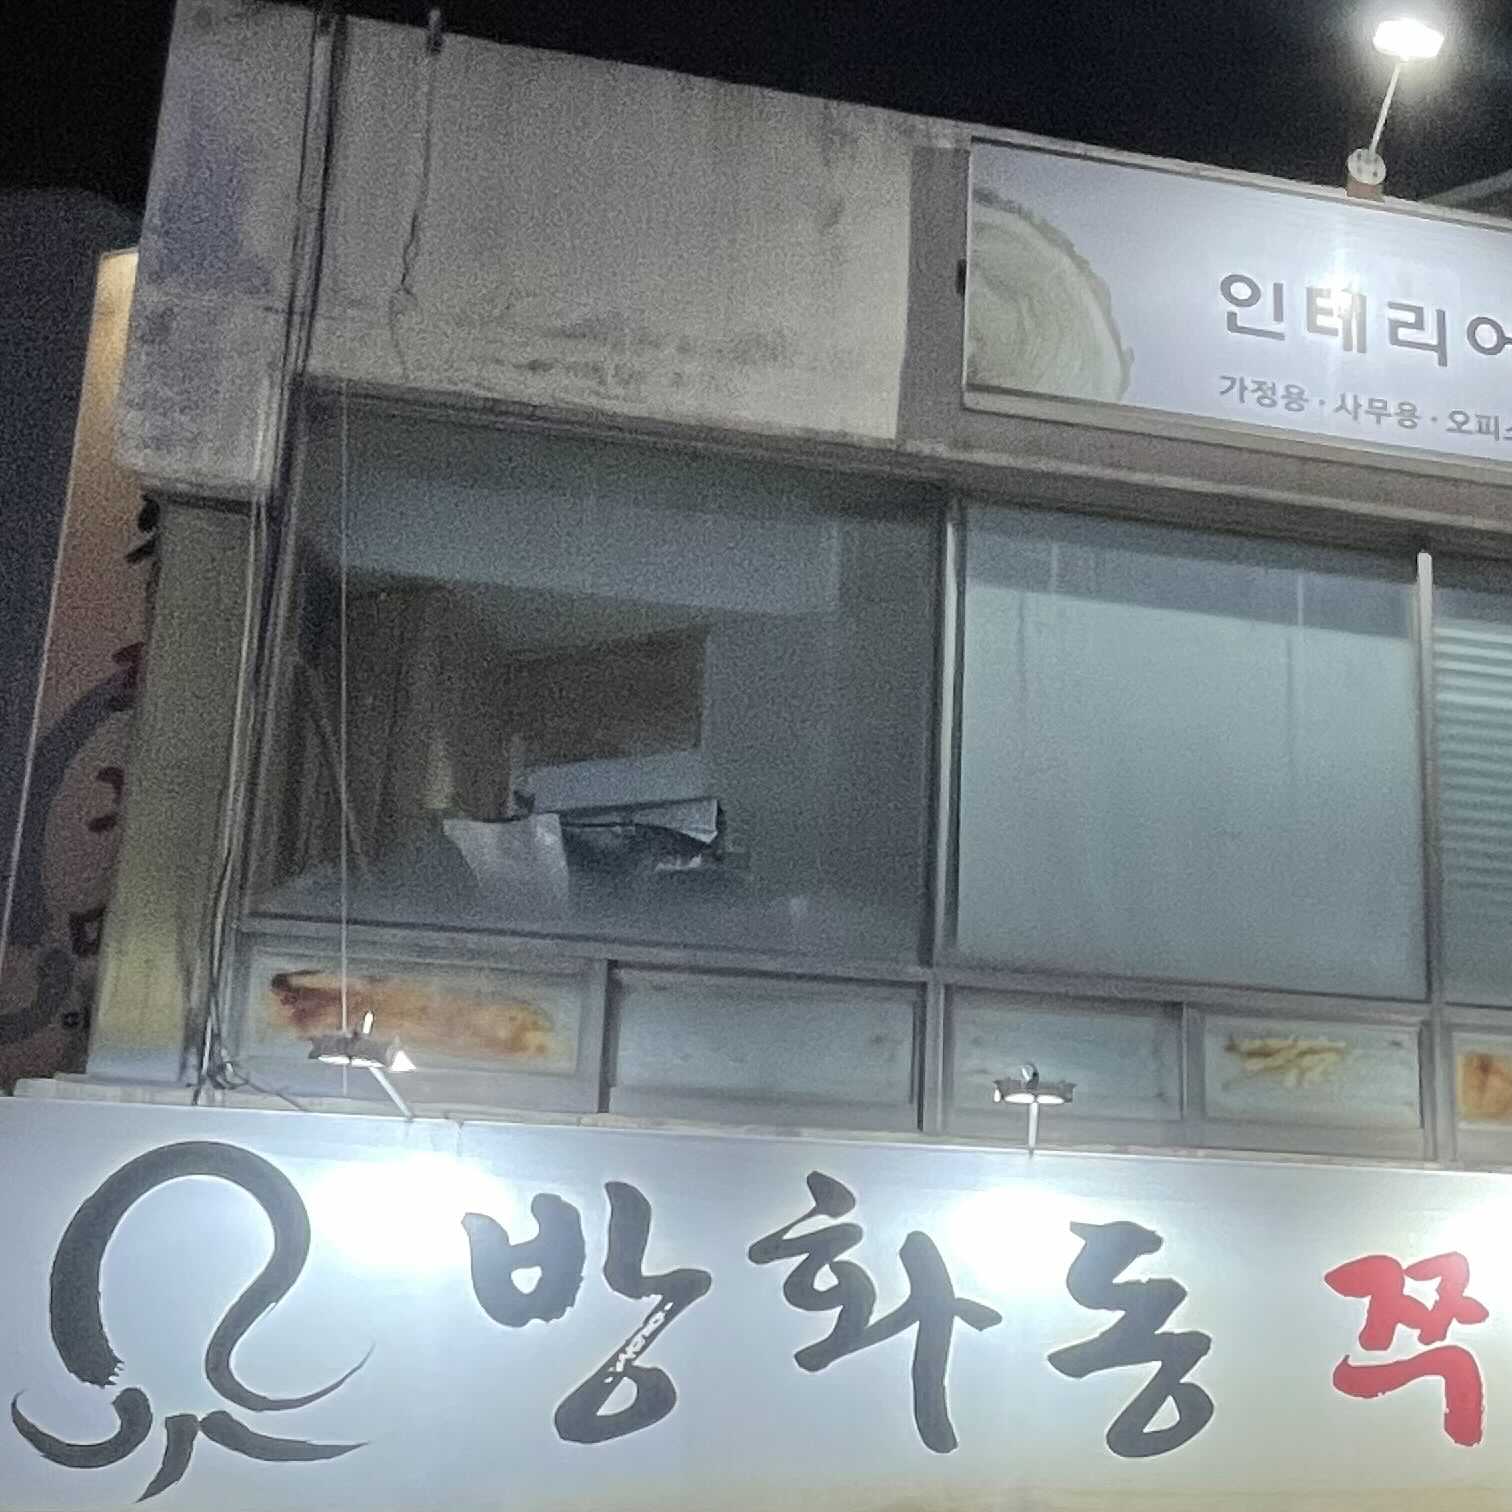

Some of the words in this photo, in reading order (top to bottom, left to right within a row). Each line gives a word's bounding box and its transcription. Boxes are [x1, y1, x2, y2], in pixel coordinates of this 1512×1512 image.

[1220, 375, 1310, 413] 가정용
[1335, 392, 1422, 430] 사무용
[461, 1170, 1215, 1459] 방화동
